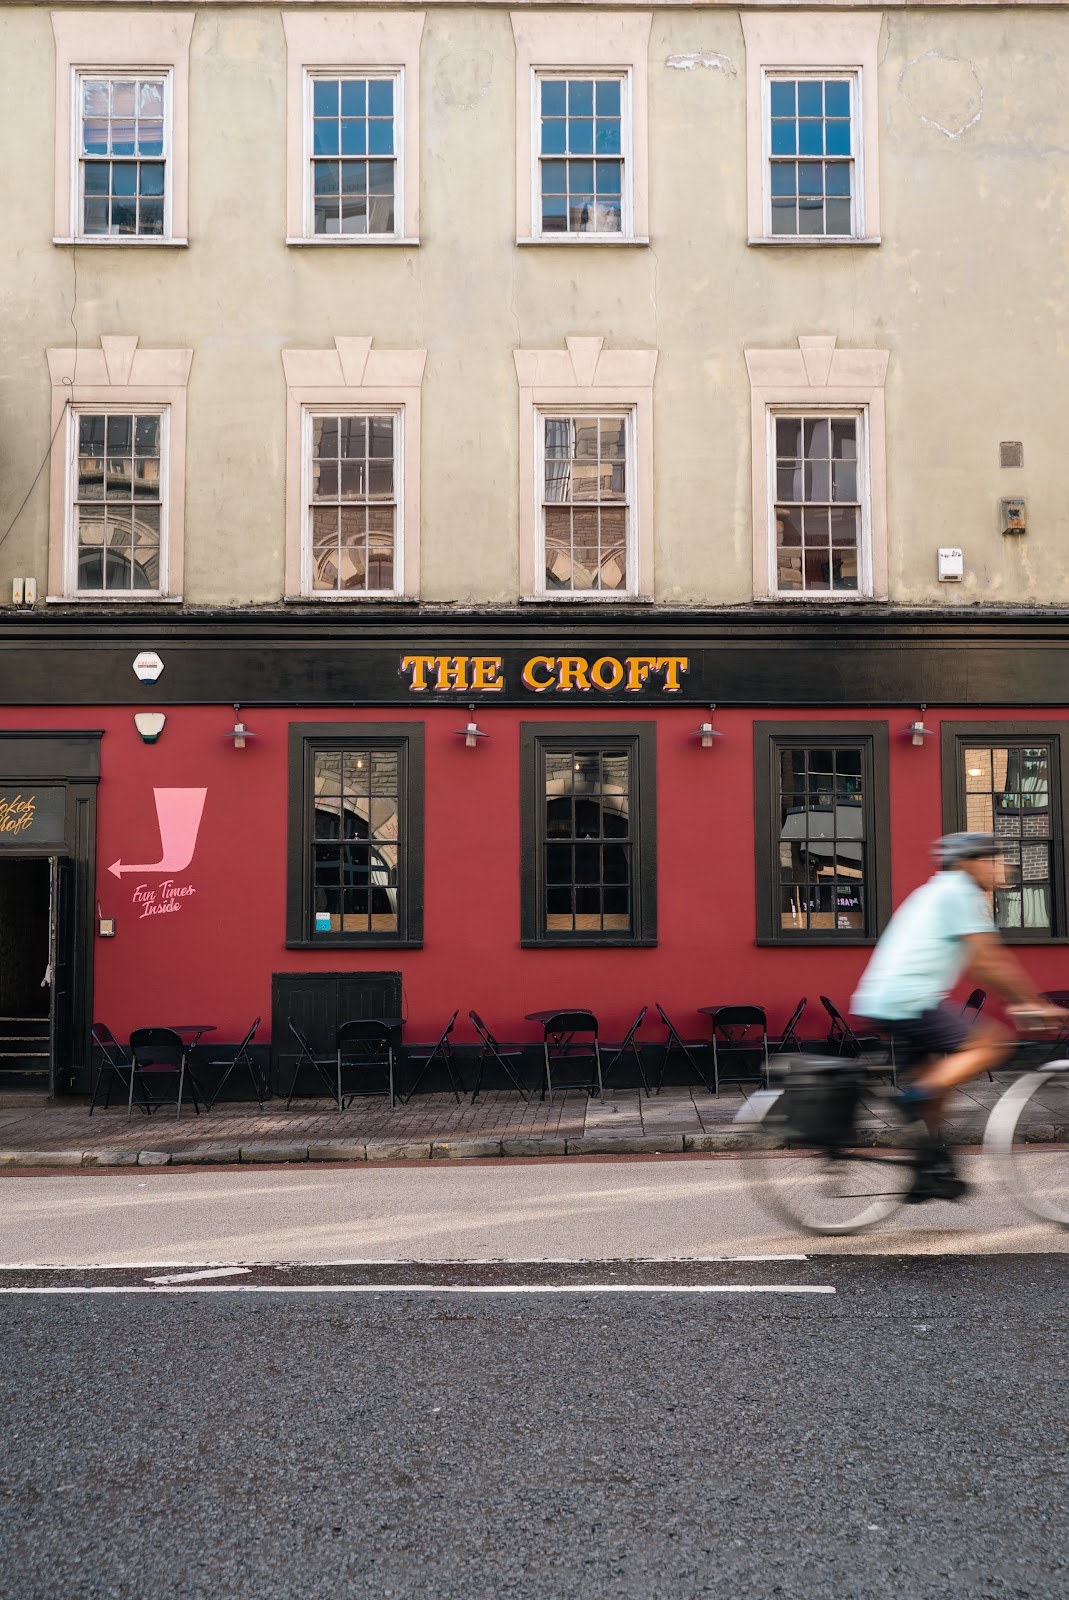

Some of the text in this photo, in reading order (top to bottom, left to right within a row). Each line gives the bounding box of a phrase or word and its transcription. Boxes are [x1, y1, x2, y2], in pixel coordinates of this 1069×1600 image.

[401, 656, 689, 692] THE CROFT
[0, 795, 36, 817] okes
[132, 880, 196, 902] Fun Times
[139, 898, 182, 918] Inside
